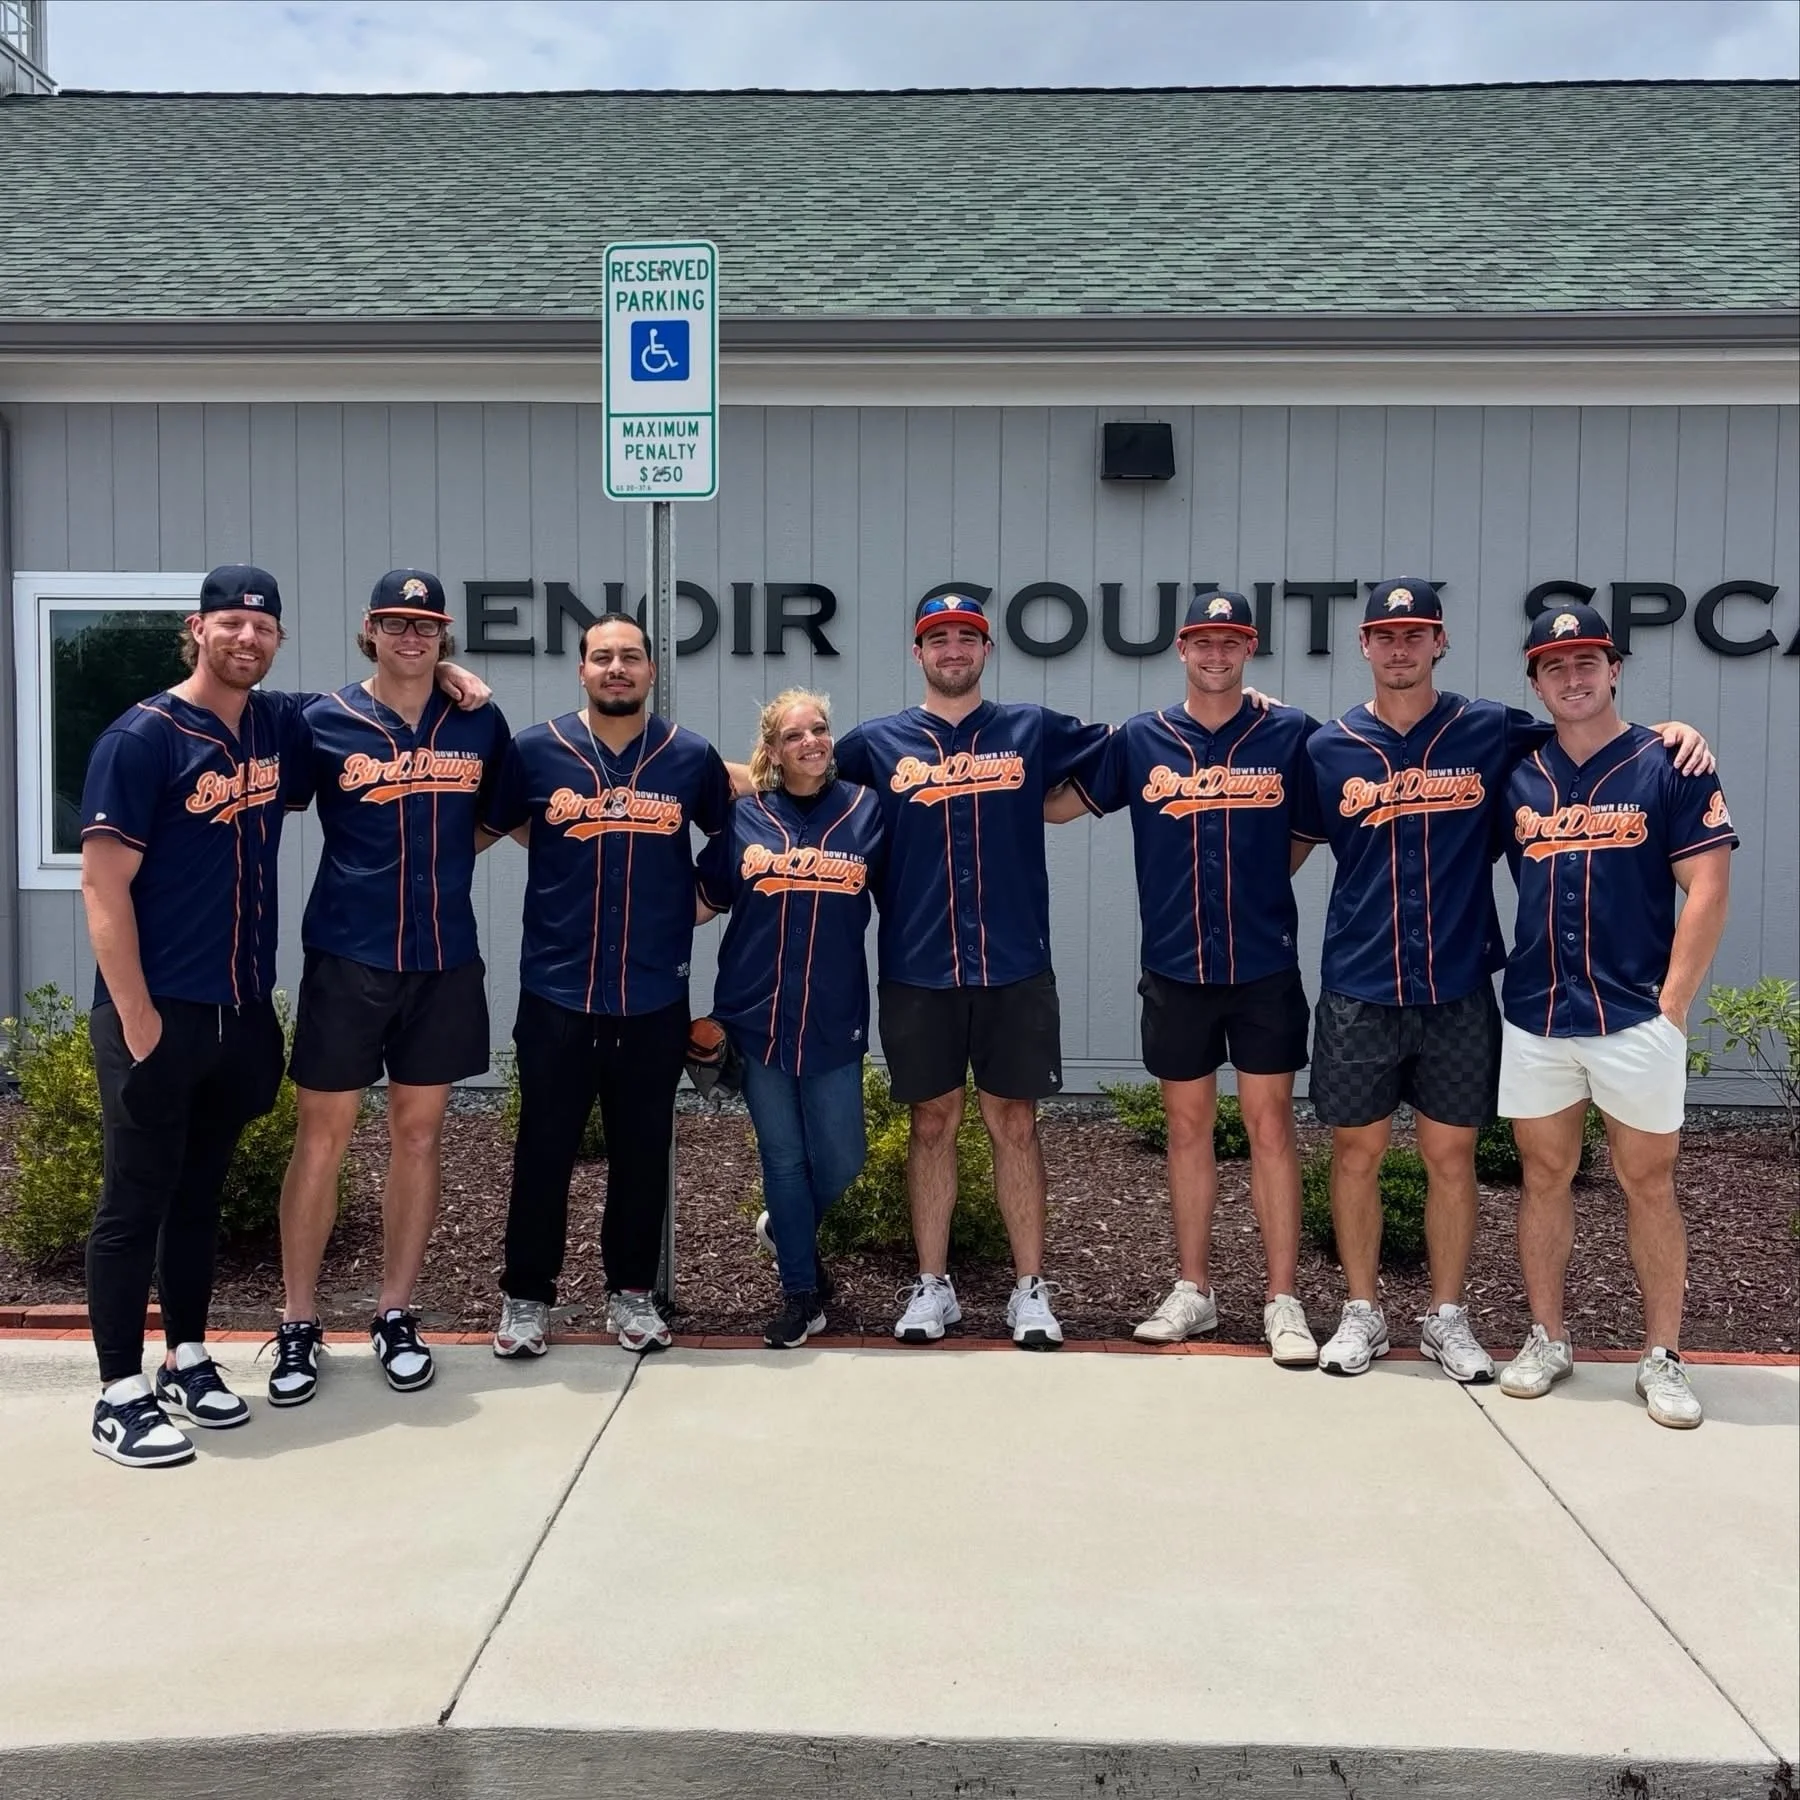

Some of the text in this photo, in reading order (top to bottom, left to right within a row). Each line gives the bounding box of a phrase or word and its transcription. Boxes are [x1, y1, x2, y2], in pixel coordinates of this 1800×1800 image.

[611, 258, 710, 283] RESERVED
[616, 289, 705, 312] PARKING
[622, 420, 700, 438] MAXIMUM
[625, 443, 697, 461] PENALTY
[640, 465, 683, 483] $250
[1524, 579, 1800, 657] SPC
[185, 762, 246, 814] Bird
[339, 751, 412, 791] Bird
[890, 752, 1025, 793] Bird Dawgs
[1142, 765, 1284, 803] Bird Dawgs
[545, 787, 611, 825] Bird
[1339, 767, 1484, 817] Bird Dawgs
[1515, 803, 1648, 845] Bird Dawgs
[741, 844, 867, 889] Bird Dawgs
